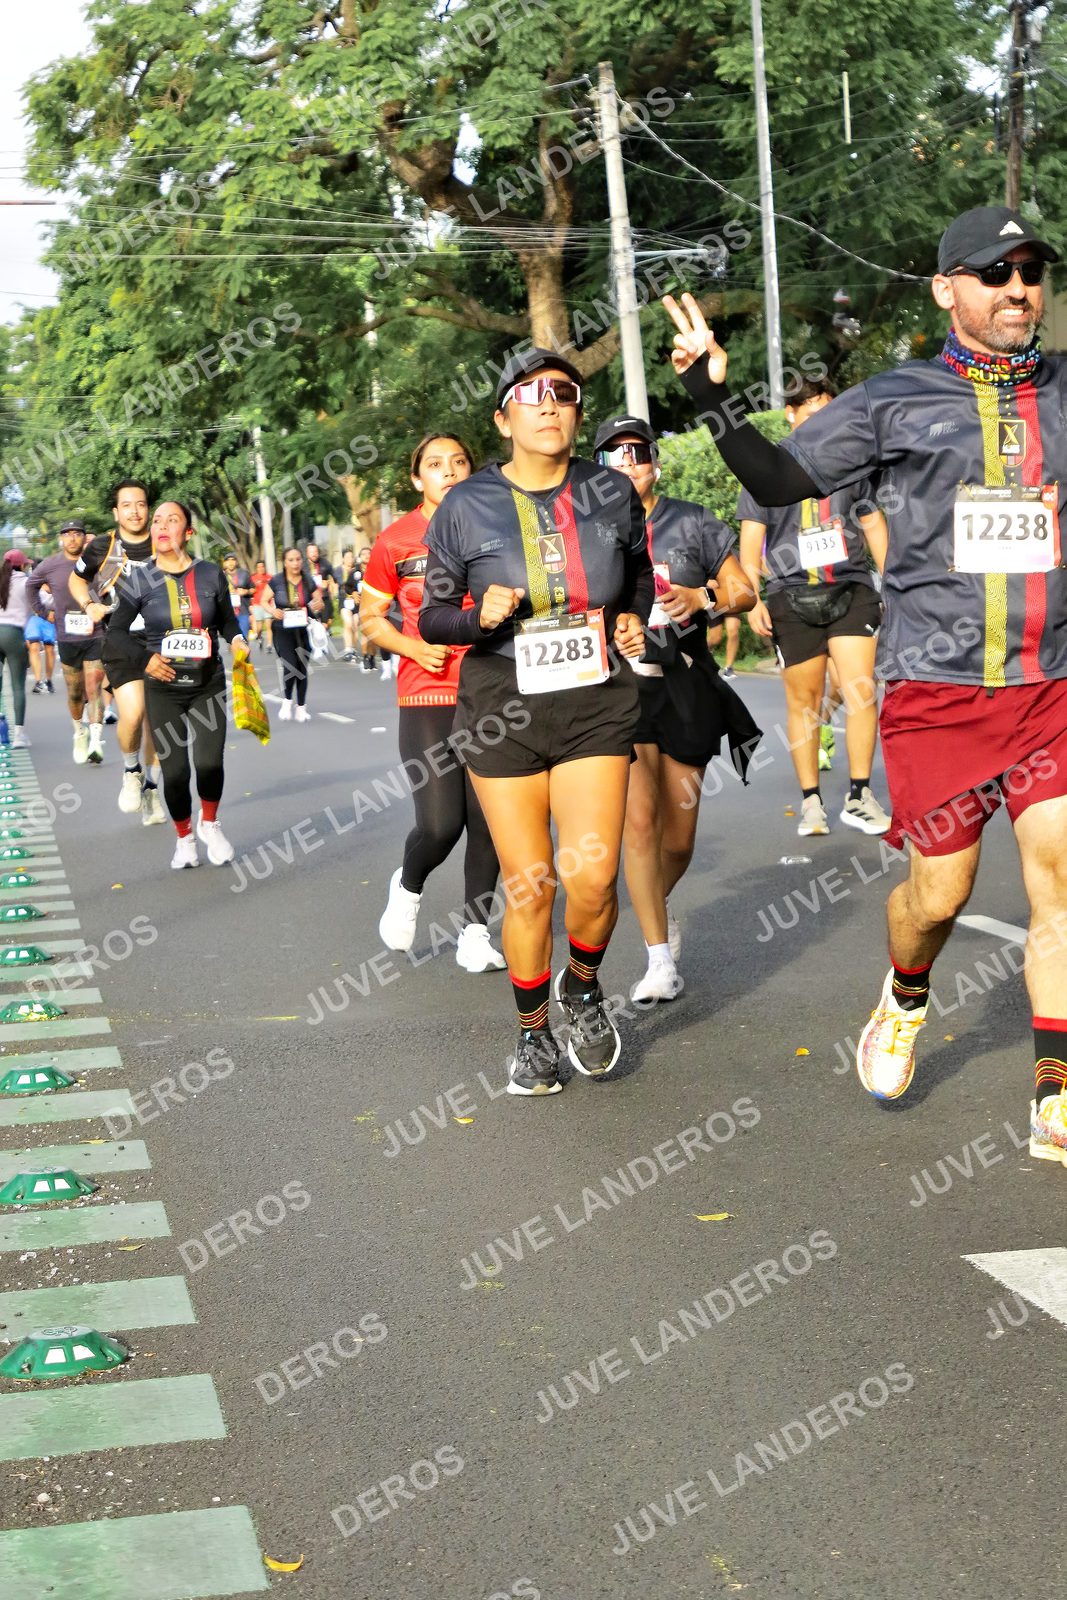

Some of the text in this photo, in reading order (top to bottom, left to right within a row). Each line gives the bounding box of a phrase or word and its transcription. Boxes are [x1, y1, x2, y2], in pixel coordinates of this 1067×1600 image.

[962, 514, 1048, 540] 12238
[806, 536, 836, 553] 9135
[167, 639, 204, 650] 12483
[520, 636, 594, 667] 12283
